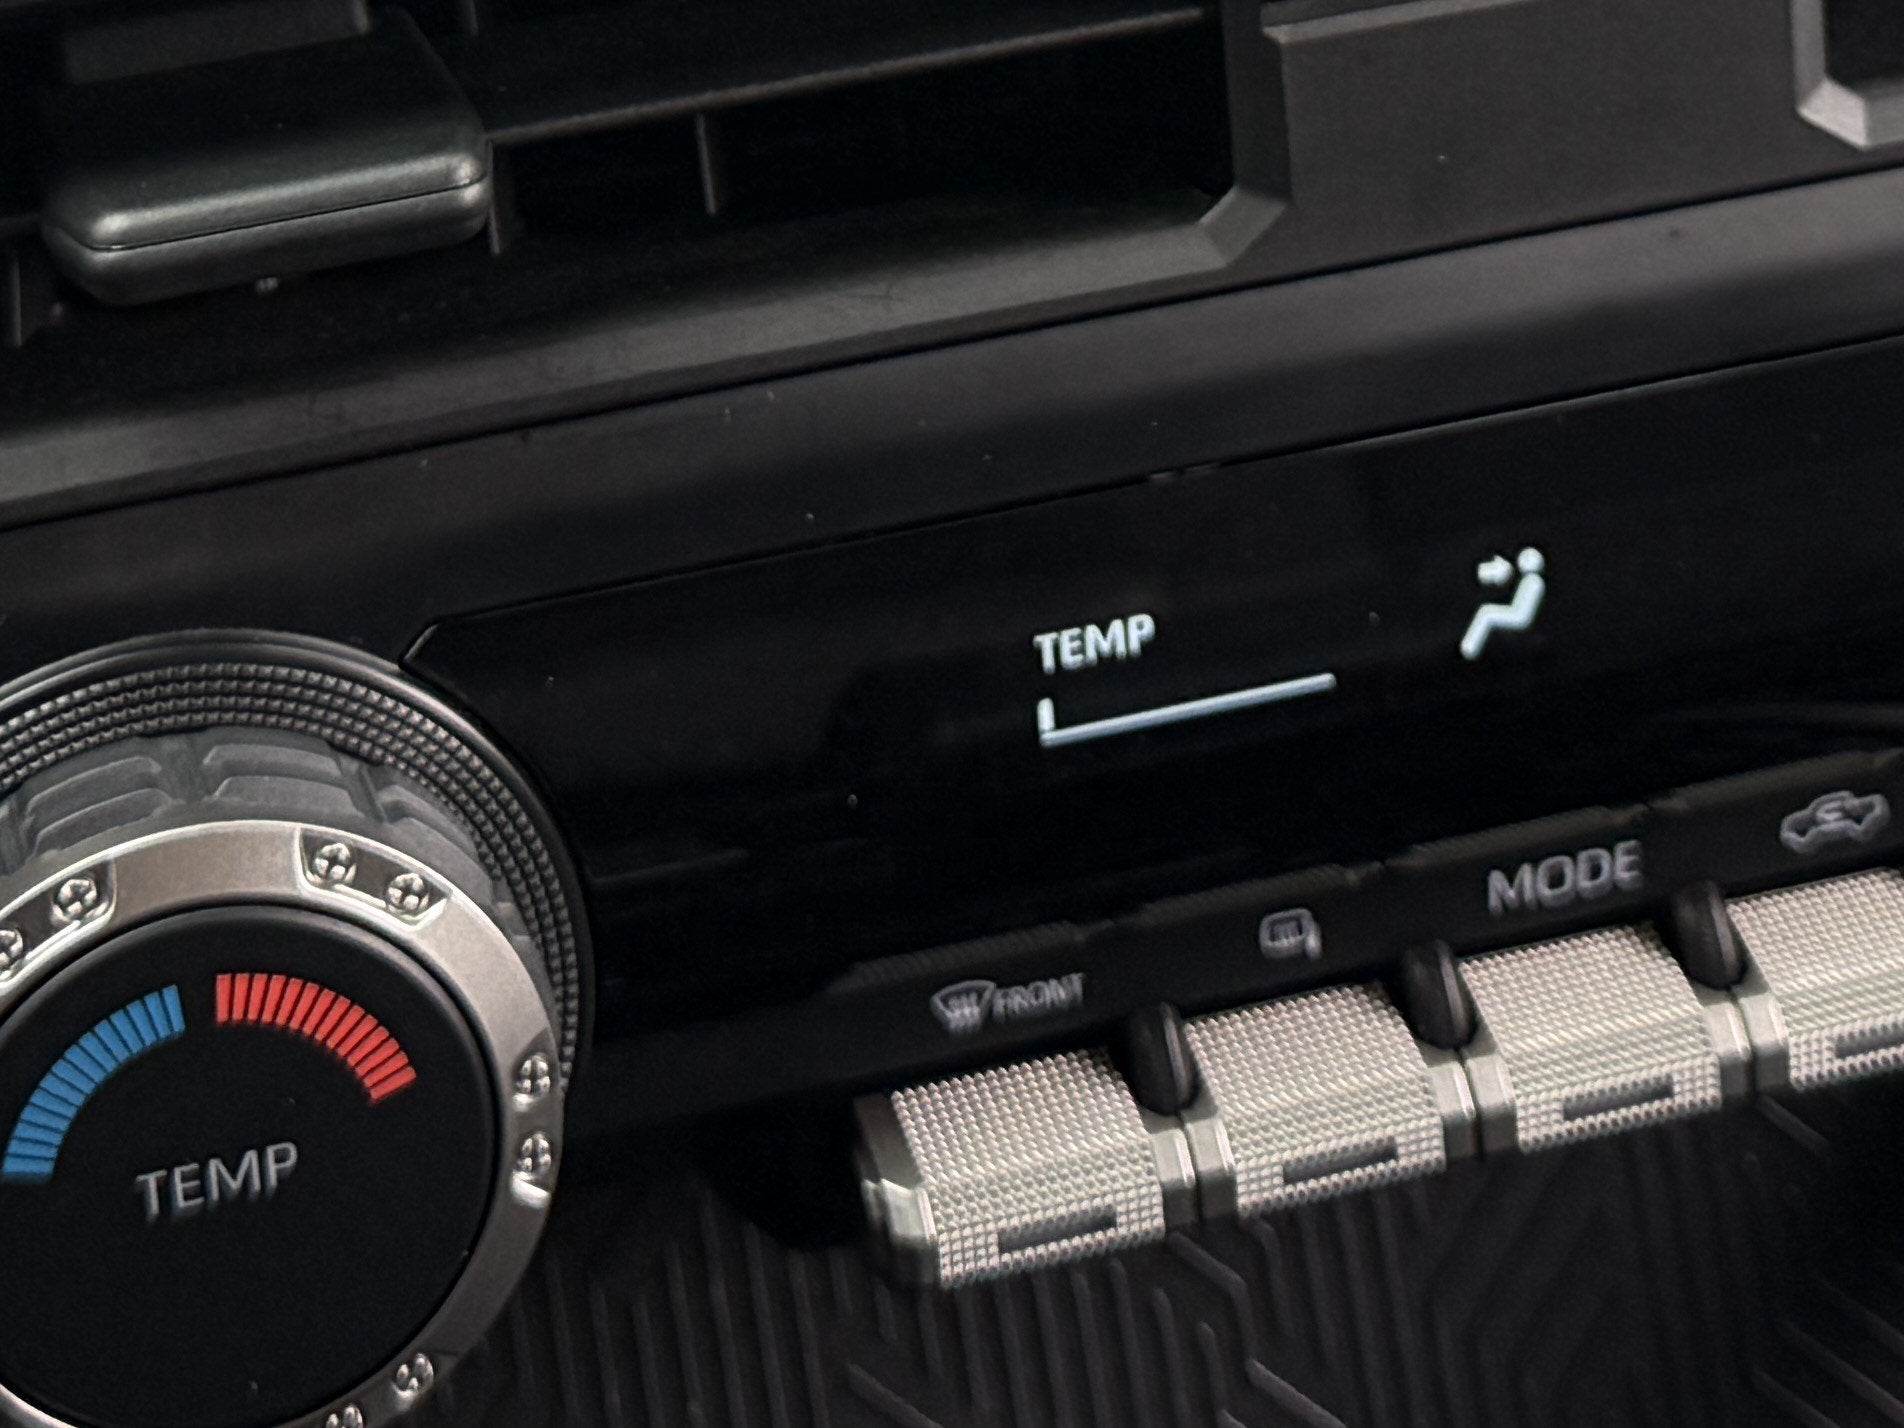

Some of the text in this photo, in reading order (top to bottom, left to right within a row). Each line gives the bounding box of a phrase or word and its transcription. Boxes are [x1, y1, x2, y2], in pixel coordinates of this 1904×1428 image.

[1033, 612, 1156, 676] TEMP
[1487, 839, 1644, 915] MODE
[993, 972, 1087, 1022] FRONT
[135, 1141, 298, 1223] TEMP
